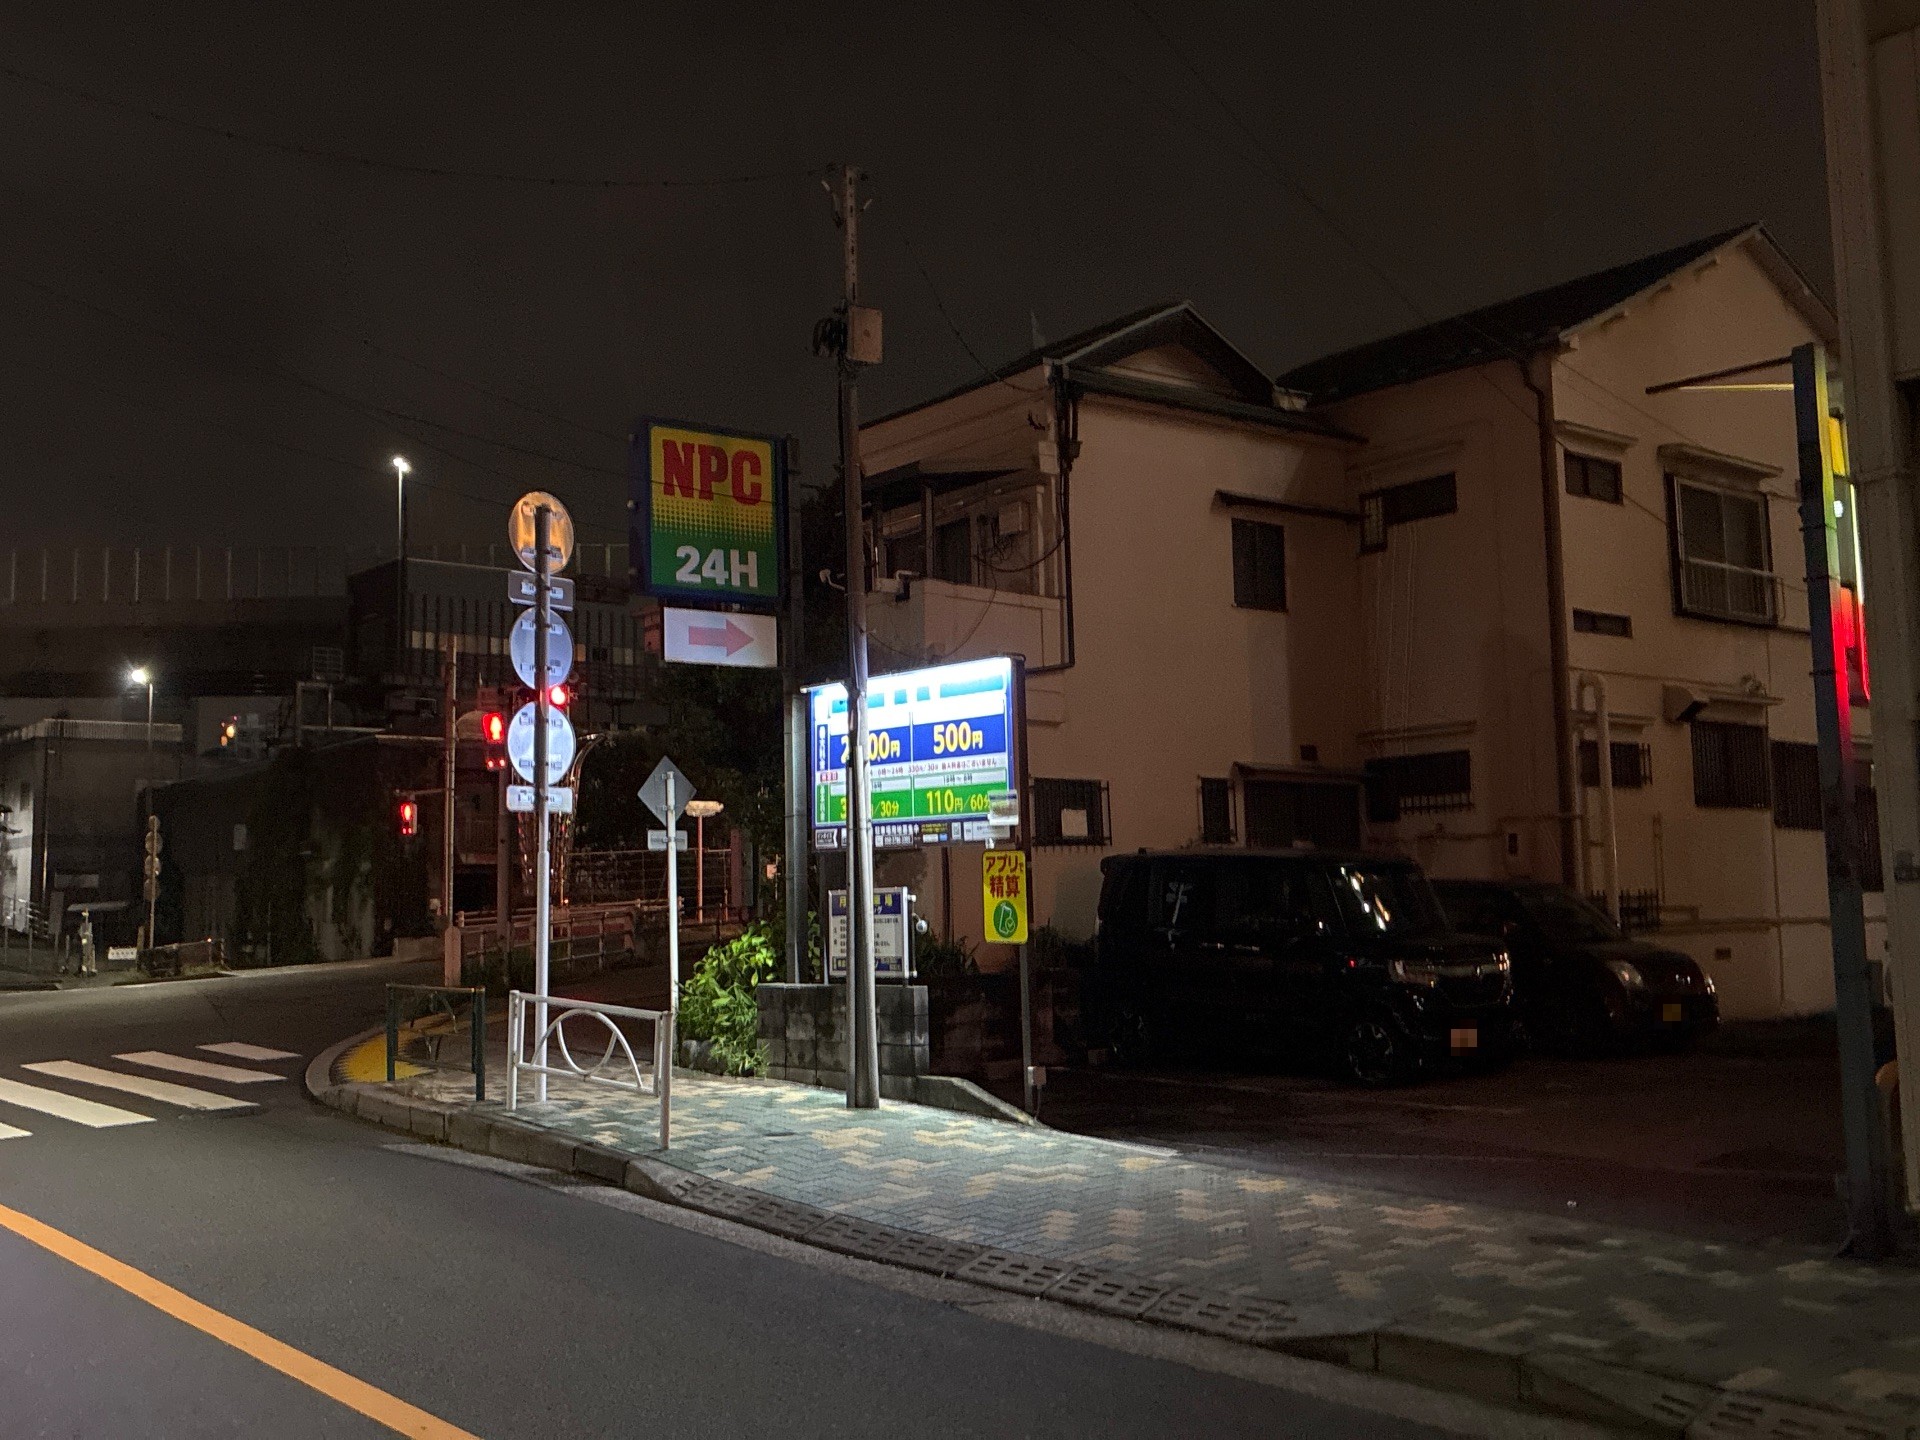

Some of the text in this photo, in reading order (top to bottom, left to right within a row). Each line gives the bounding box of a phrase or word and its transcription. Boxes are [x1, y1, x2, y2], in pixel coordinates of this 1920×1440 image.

[662, 438, 763, 506] NPC
[676, 545, 758, 588] 24H
[933, 721, 983, 755] 500円
[989, 874, 1021, 898] 精算
